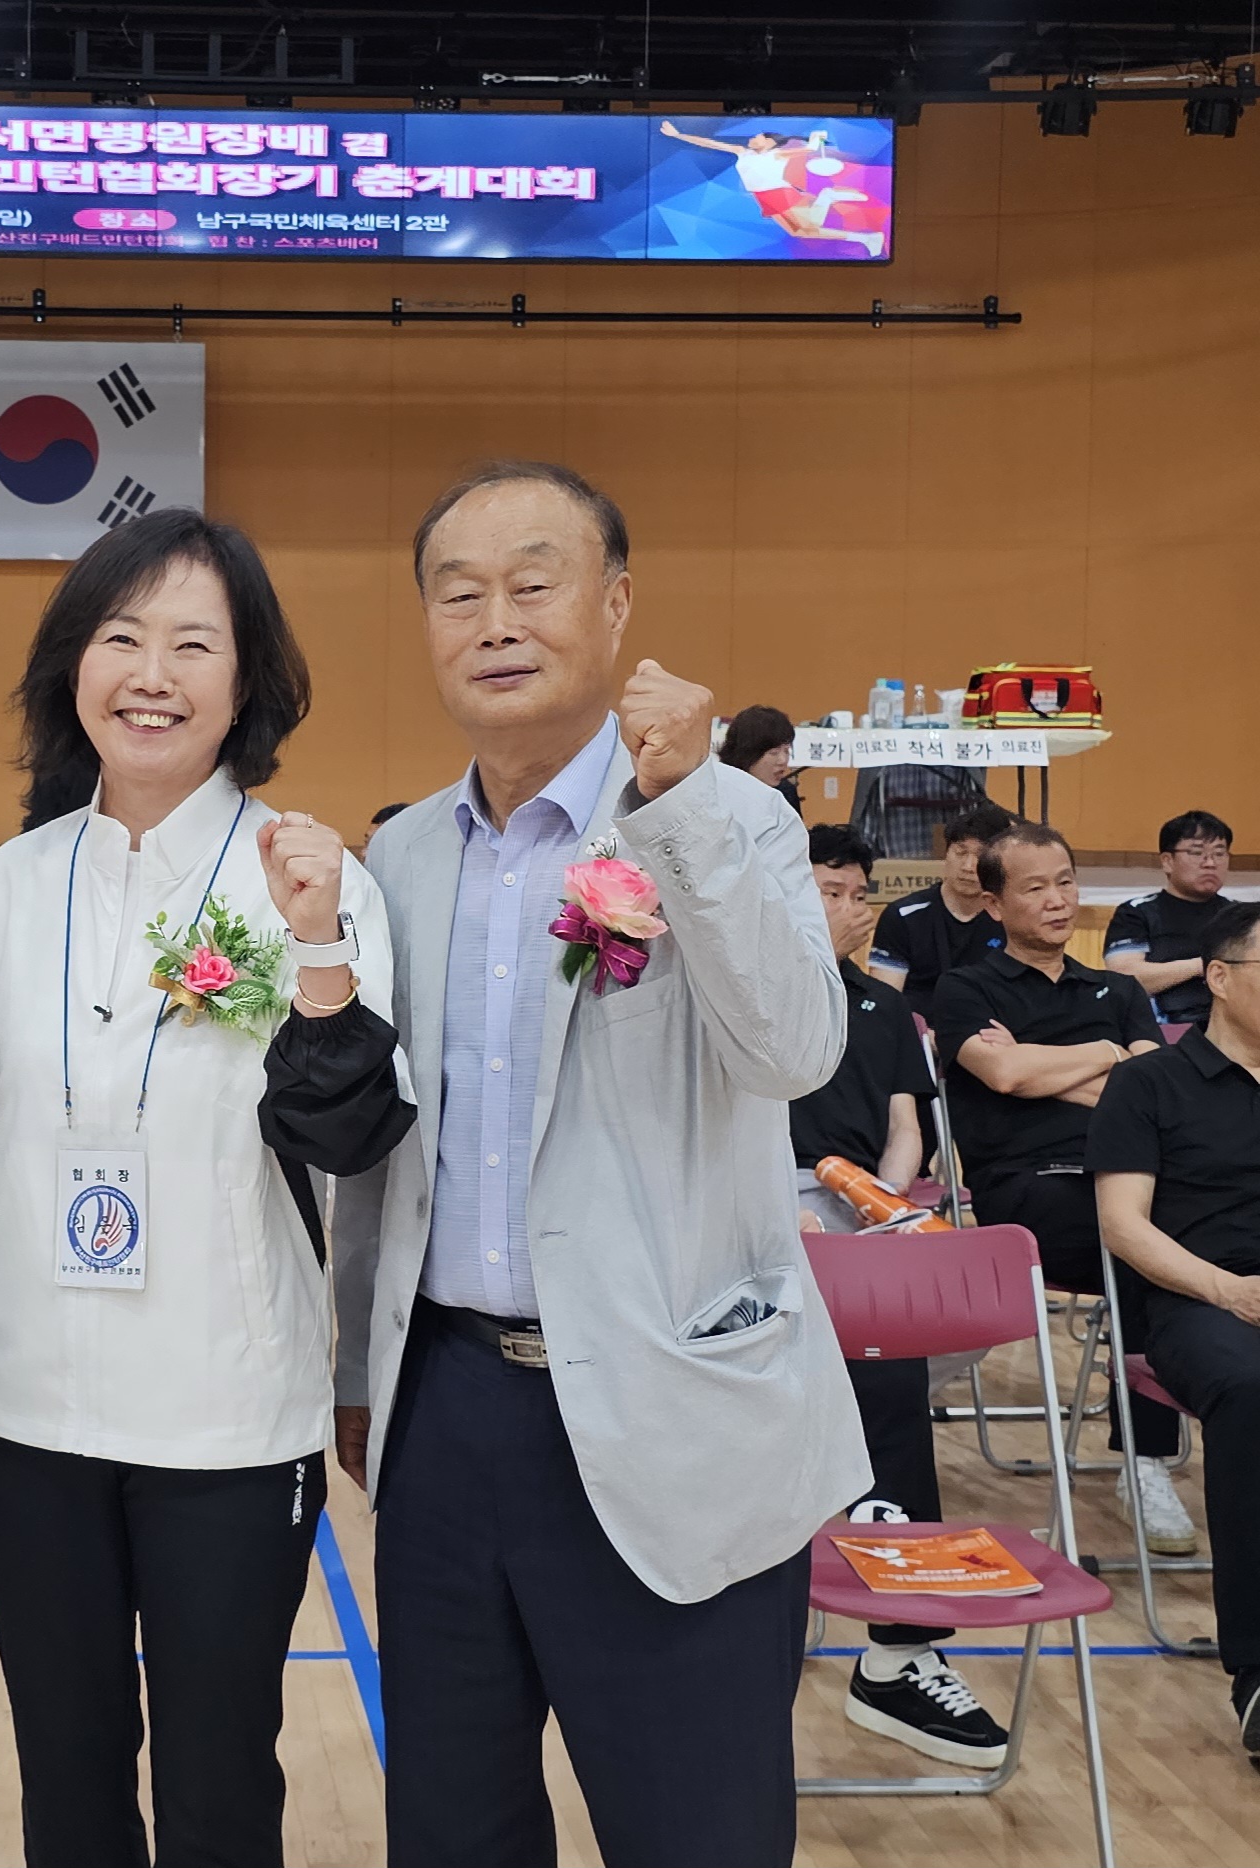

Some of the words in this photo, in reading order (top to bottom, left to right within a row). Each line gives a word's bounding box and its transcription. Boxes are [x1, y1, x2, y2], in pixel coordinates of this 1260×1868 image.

[340, 132, 388, 157] 겸
[352, 163, 596, 200] 춘계대회
[196, 211, 401, 232] 남구국민체육센터
[405, 214, 450, 232] 2관
[274, 236, 379, 250] 스포츠베어
[809, 742, 845, 761] 불가
[856, 739, 898, 754] 의료진
[908, 741, 944, 759] 착석
[955, 742, 993, 761] 불가
[1001, 740, 1042, 754] 의료진
[885, 876, 904, 888] LA
